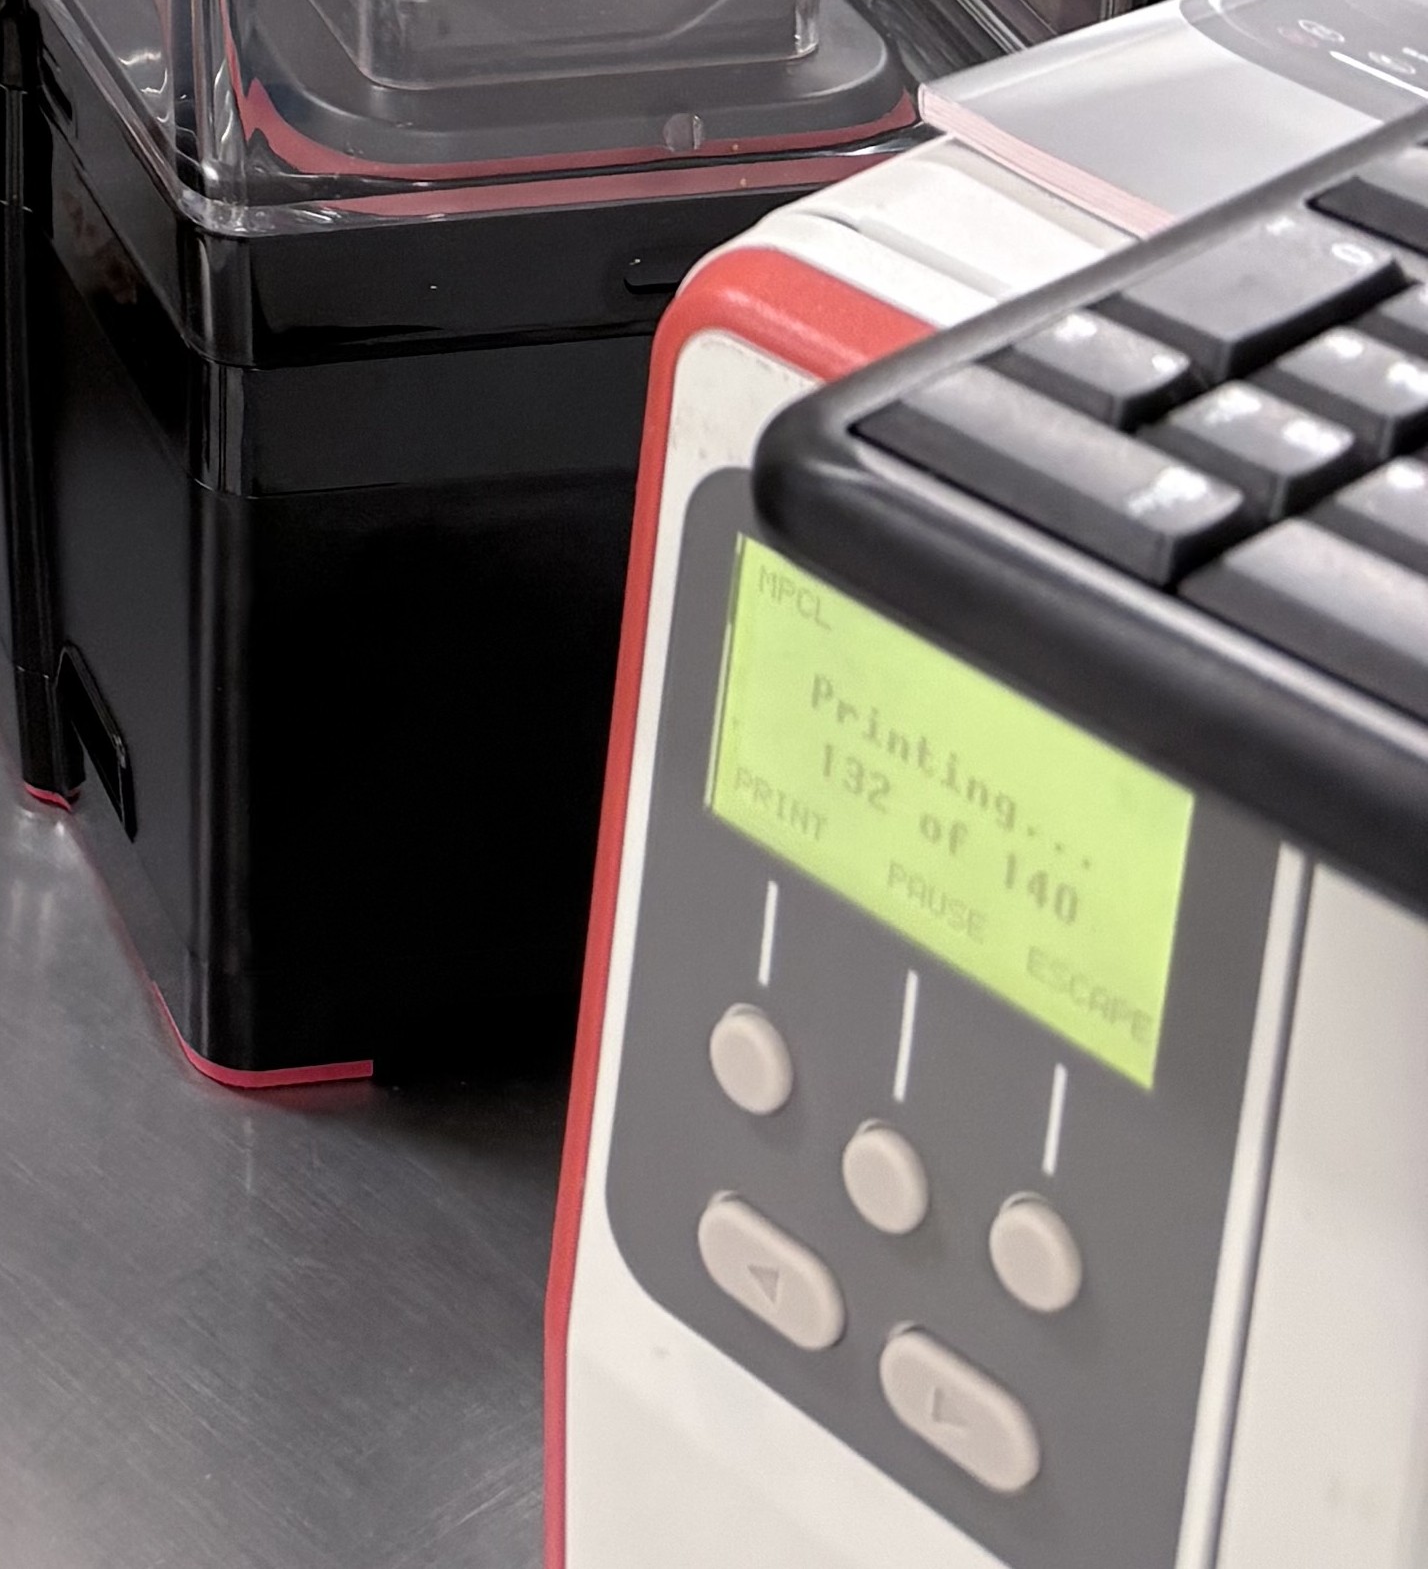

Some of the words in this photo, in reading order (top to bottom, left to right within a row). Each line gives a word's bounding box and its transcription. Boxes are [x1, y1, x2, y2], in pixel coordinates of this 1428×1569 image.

[756, 565, 832, 631] MPCL
[811, 674, 1093, 870] Printing...
[823, 742, 892, 814] 132
[919, 812, 969, 856] of
[1004, 852, 1080, 926] 140
[733, 765, 829, 843] PRINT
[886, 859, 989, 944] PAUSE
[1025, 945, 1154, 1043] ESCAPE
